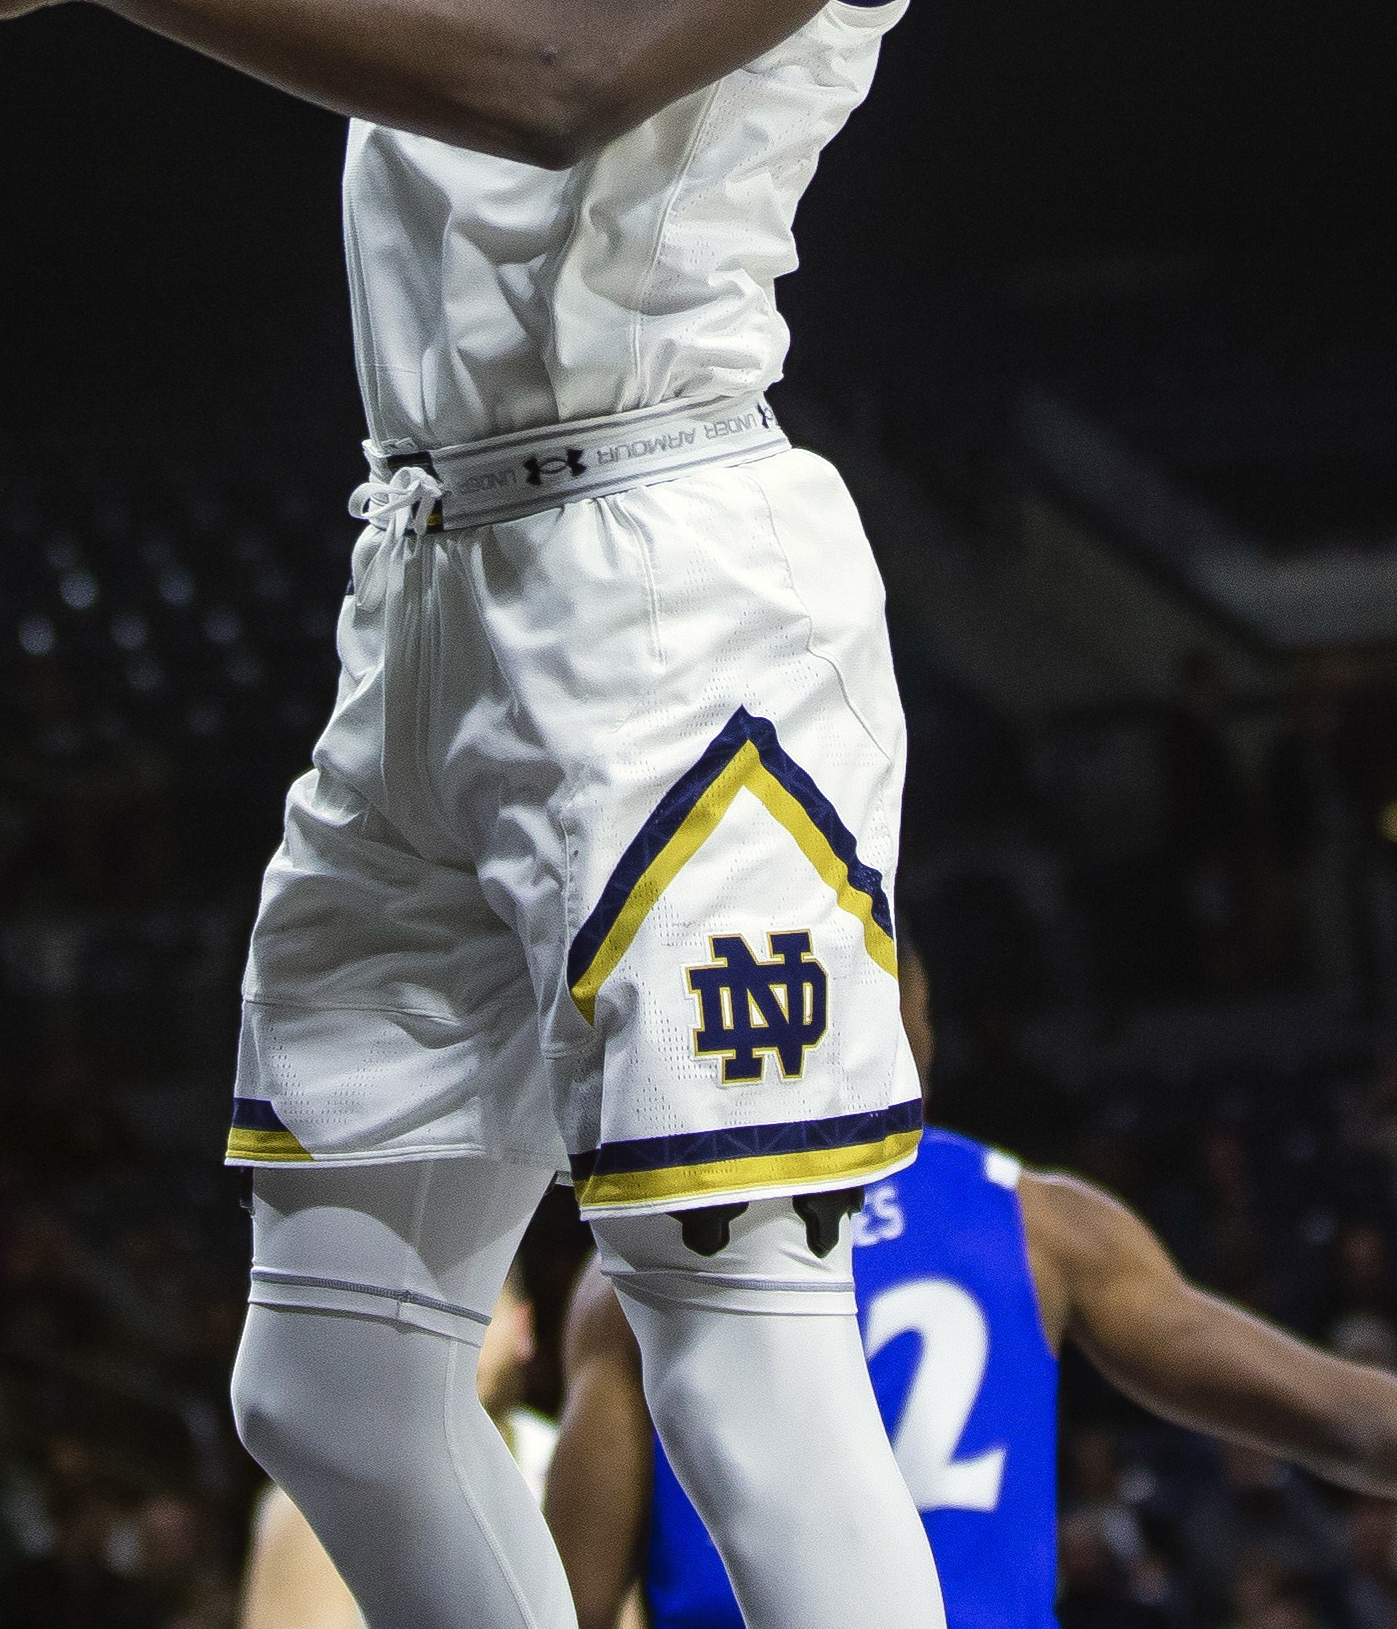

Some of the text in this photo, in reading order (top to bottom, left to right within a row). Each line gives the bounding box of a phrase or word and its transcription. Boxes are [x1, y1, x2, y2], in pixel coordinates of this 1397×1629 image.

[596, 413, 757, 467] UNDER ARMOUR
[686, 929, 829, 1086] ND
[851, 1185, 905, 1247] ES
